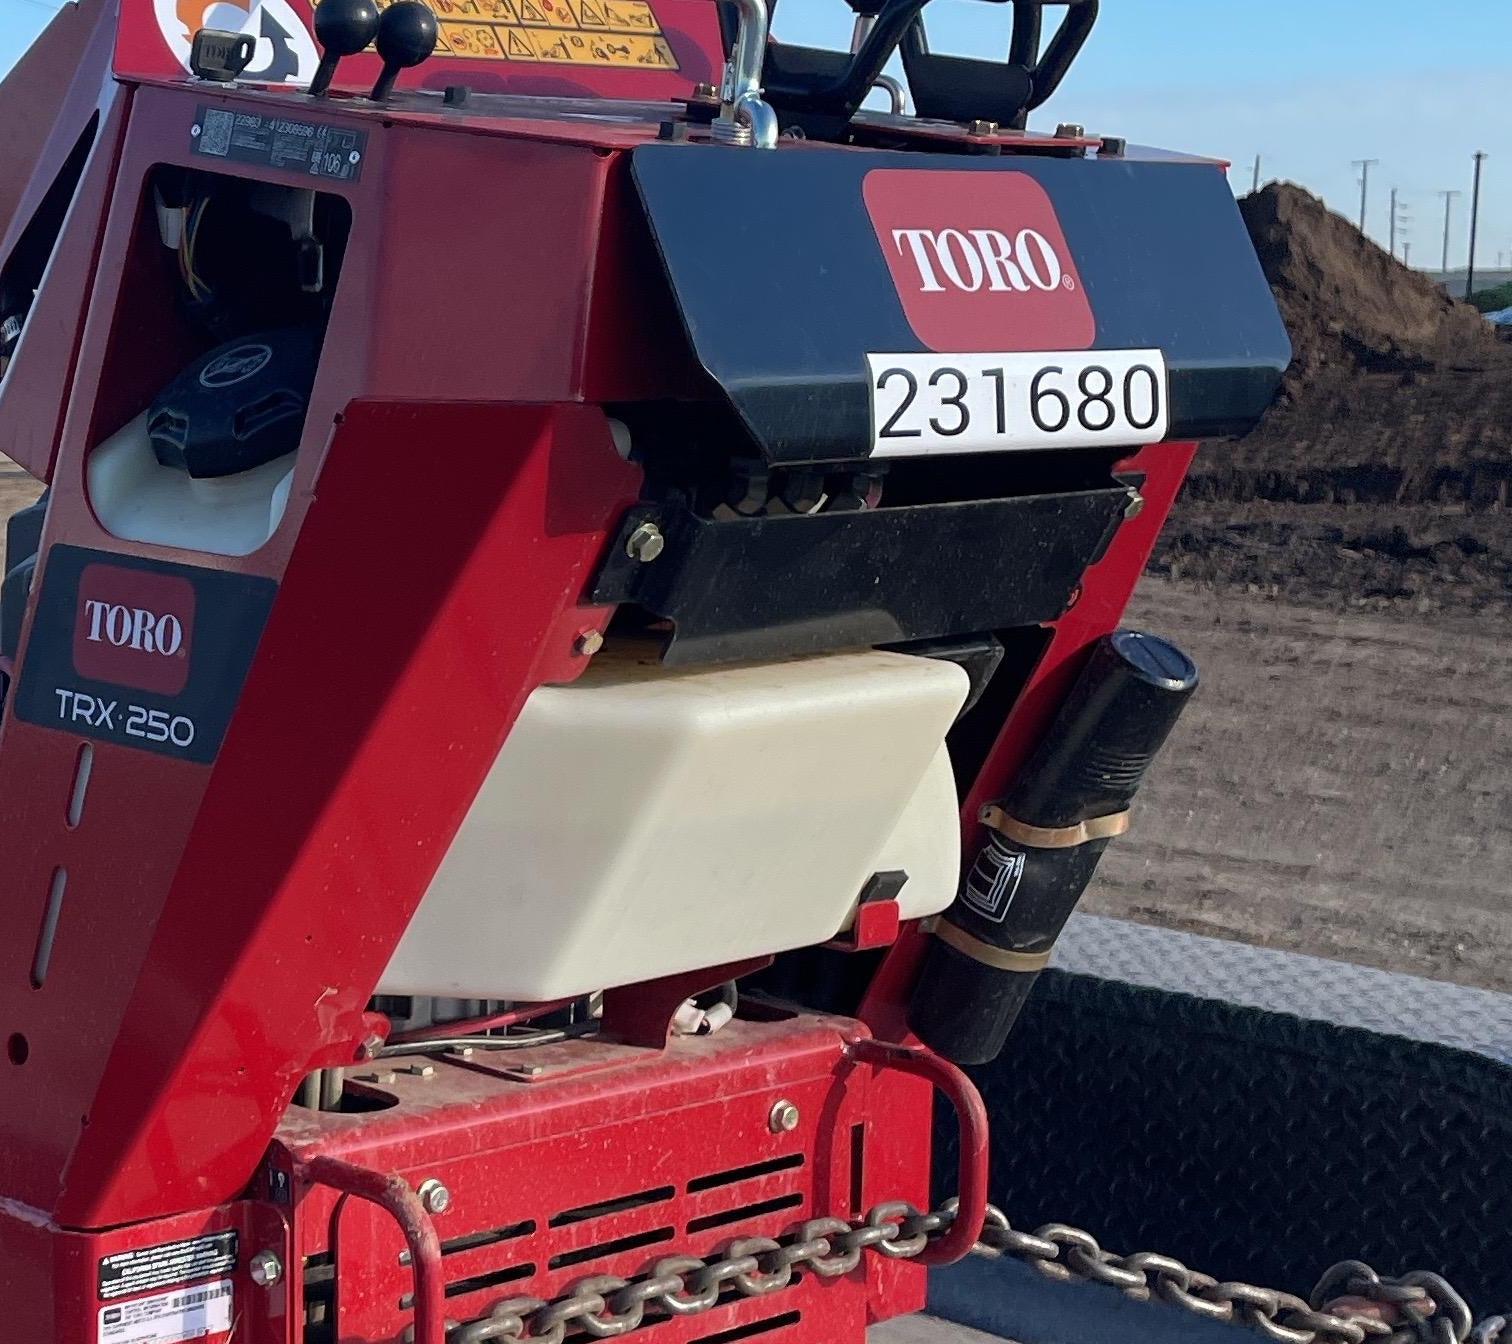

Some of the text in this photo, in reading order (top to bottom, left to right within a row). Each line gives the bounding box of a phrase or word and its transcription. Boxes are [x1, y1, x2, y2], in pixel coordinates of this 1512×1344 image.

[892, 228, 1061, 292] TORO
[875, 363, 1160, 440] 231680
[85, 599, 183, 656] TORO
